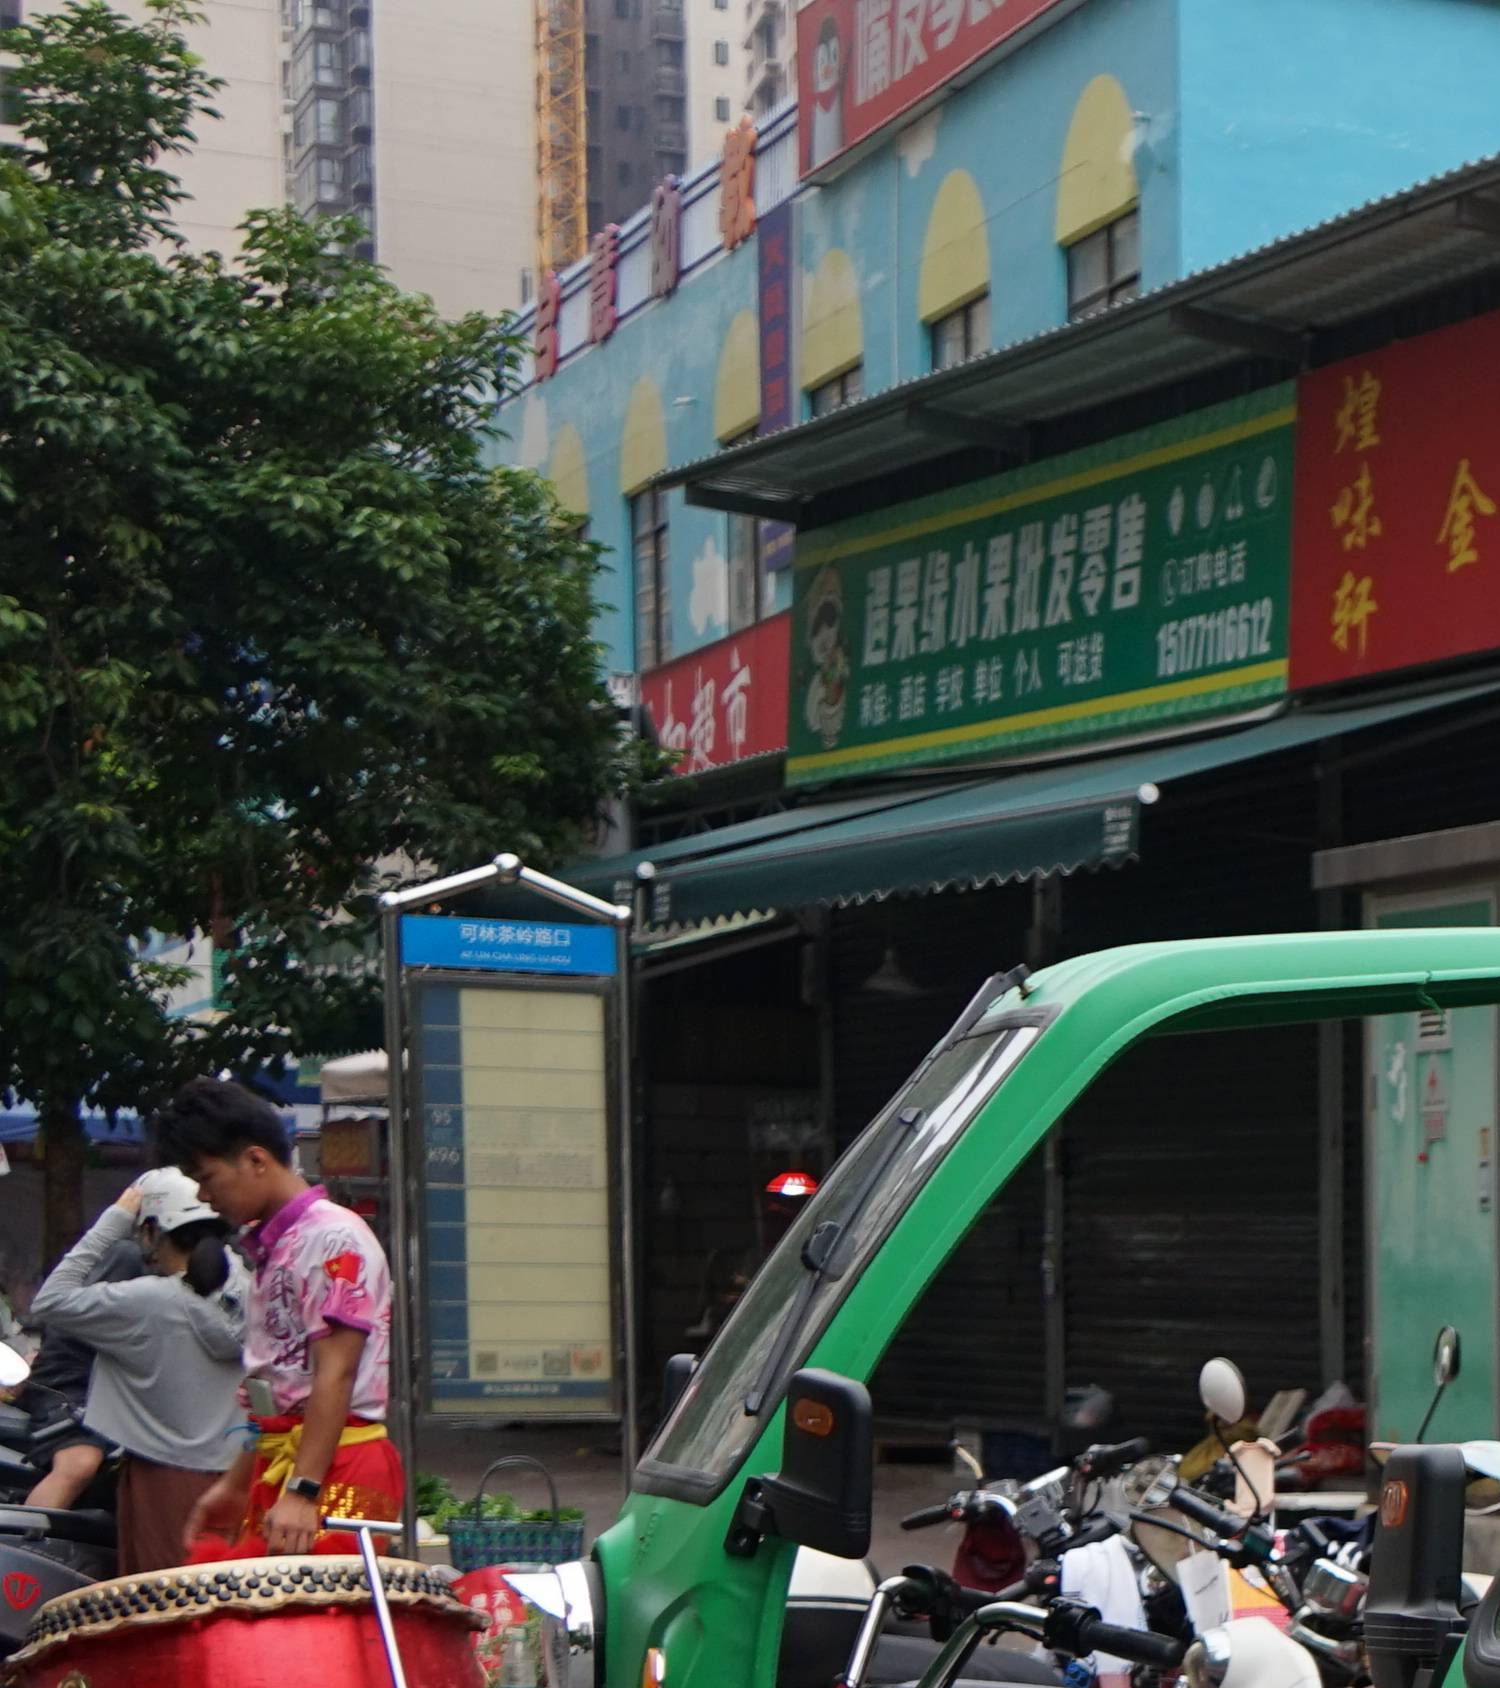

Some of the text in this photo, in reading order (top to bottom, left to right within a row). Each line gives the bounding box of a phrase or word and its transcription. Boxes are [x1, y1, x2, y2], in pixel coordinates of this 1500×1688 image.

[1329, 373, 1383, 661] 煌味轩
[1014, 647, 1042, 698] 个人
